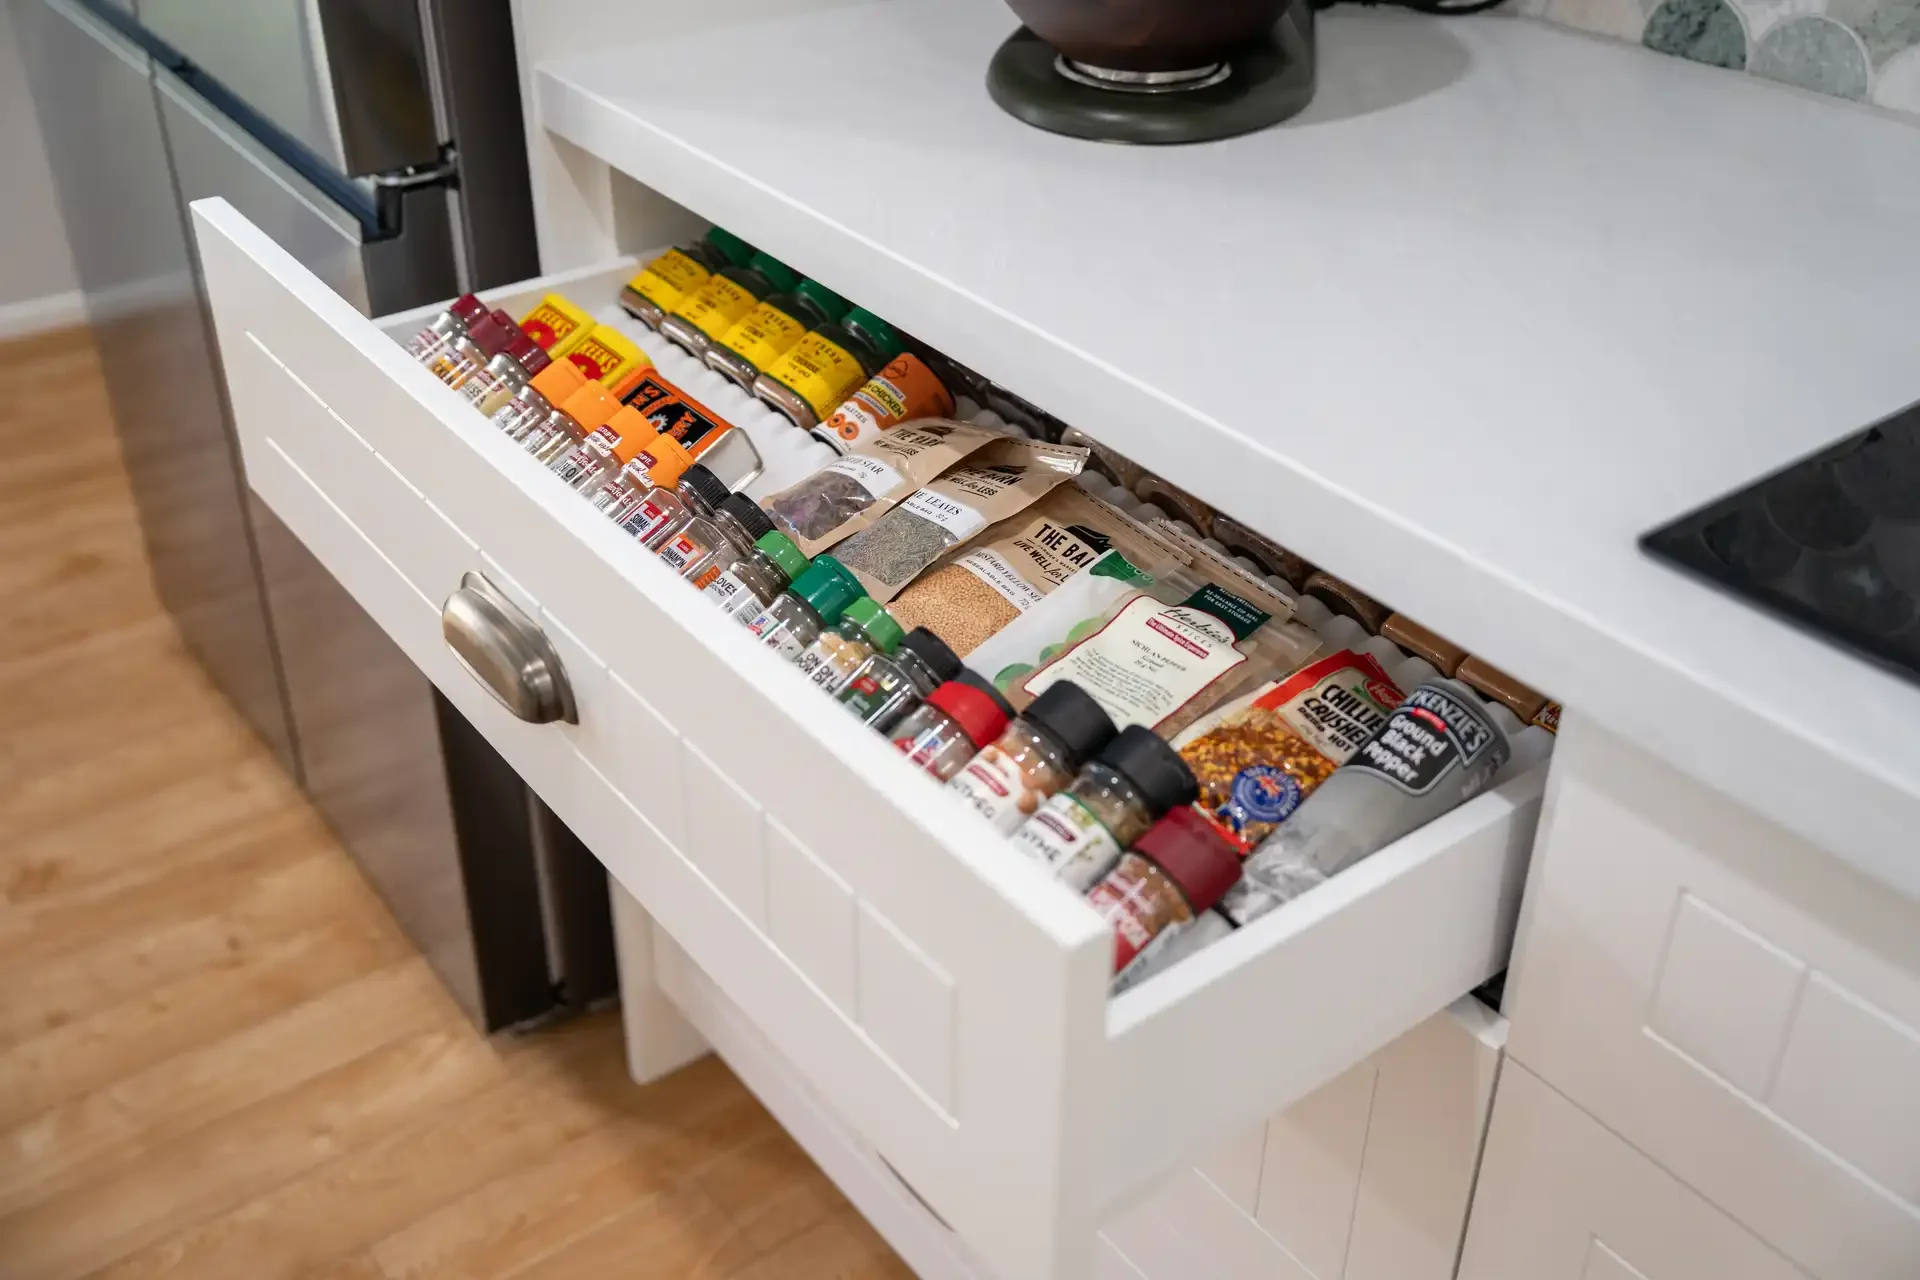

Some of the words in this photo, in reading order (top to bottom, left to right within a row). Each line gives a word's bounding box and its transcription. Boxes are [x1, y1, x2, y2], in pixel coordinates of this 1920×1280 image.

[871, 385, 905, 417] CHICKEN
[925, 494, 962, 516] LEAVES
[977, 487, 998, 496] LESS
[1013, 540, 1033, 552] LIVE
[1029, 549, 1051, 570] WELL
[1044, 567, 1062, 578] for
[1034, 523, 1068, 551] THE
[1061, 543, 1095, 568] BA
[965, 559, 1001, 584] RESEALABLE
[1001, 584, 1016, 596] BAG
[1002, 568, 1030, 594] YELLOW
[1226, 608, 1252, 624] STORAGE
[1175, 625, 1212, 648] SPICES
[1389, 714, 1448, 756] Ground
[1409, 690, 1487, 752] KENZIE'S
[1328, 733, 1353, 752] HOT
[1380, 730, 1427, 766] Black
[1362, 741, 1420, 782] Pepper
